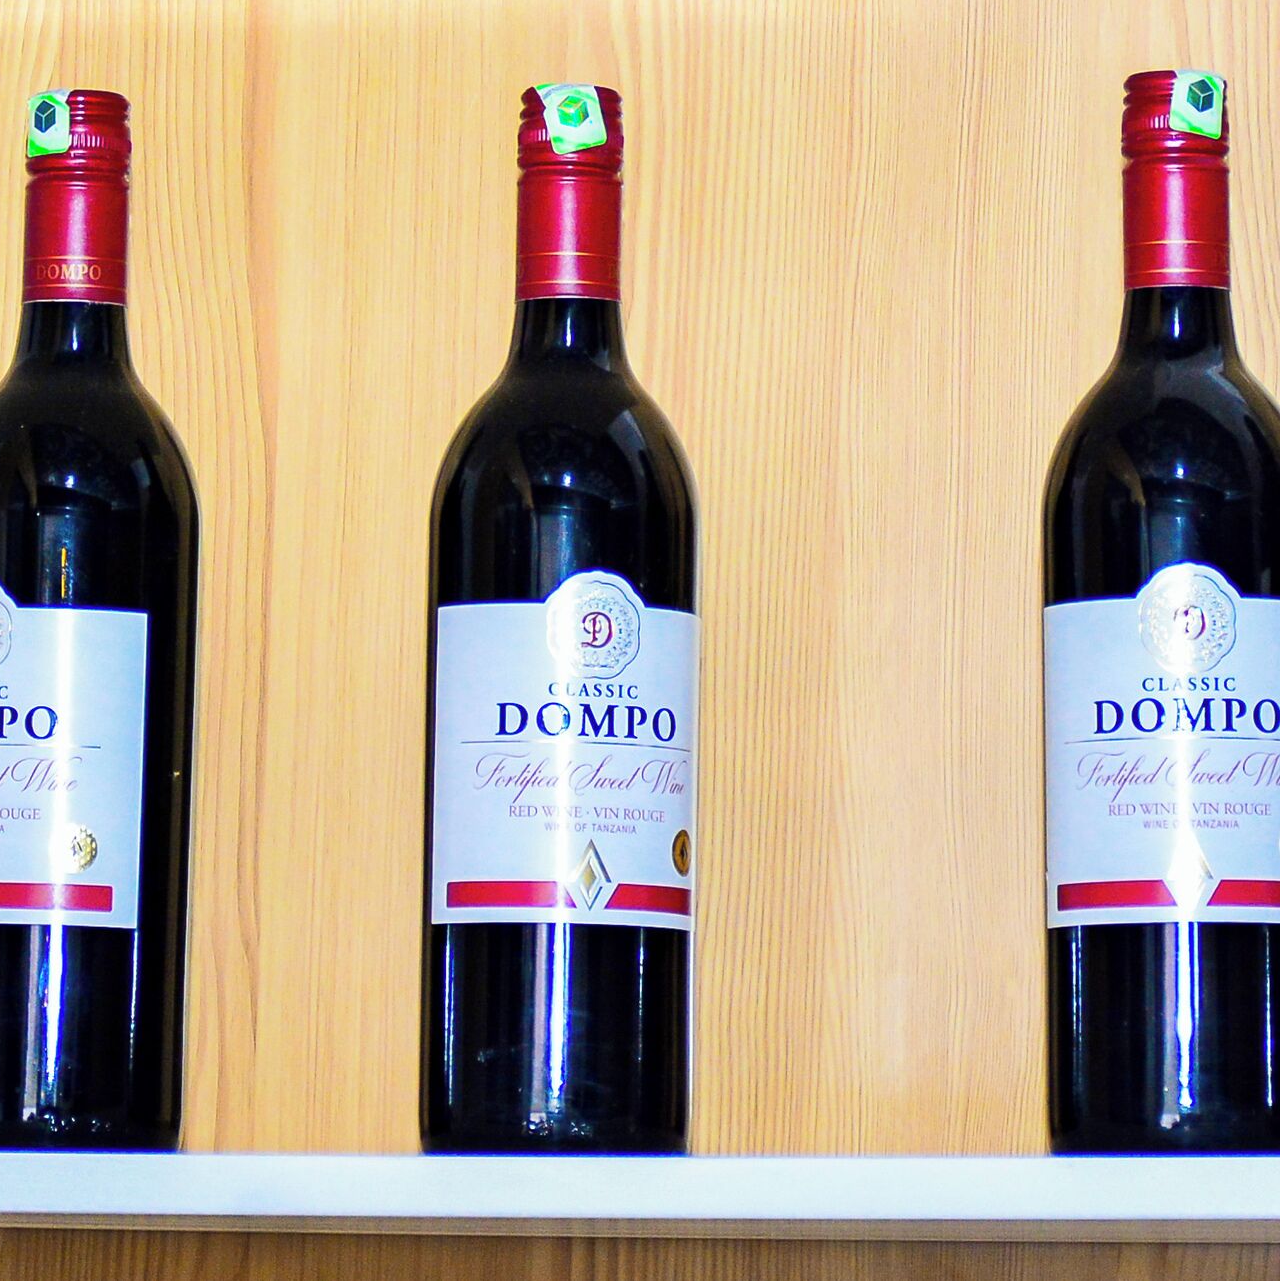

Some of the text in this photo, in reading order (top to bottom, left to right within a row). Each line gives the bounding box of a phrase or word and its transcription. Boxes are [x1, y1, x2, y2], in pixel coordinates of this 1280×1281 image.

[1142, 677, 1236, 692] CLASSIC
[495, 702, 677, 742] DOMPO
[509, 805, 538, 818] RED
[593, 806, 620, 820] VIN
[623, 809, 665, 823] ROUGE
[1108, 803, 1136, 816] RED
[1191, 803, 1220, 816] VIN
[1224, 803, 1272, 816] ROUGE
[574, 823, 587, 832] OF
[592, 823, 637, 834] TANZANIA
[1143, 820, 1169, 829] WINE
